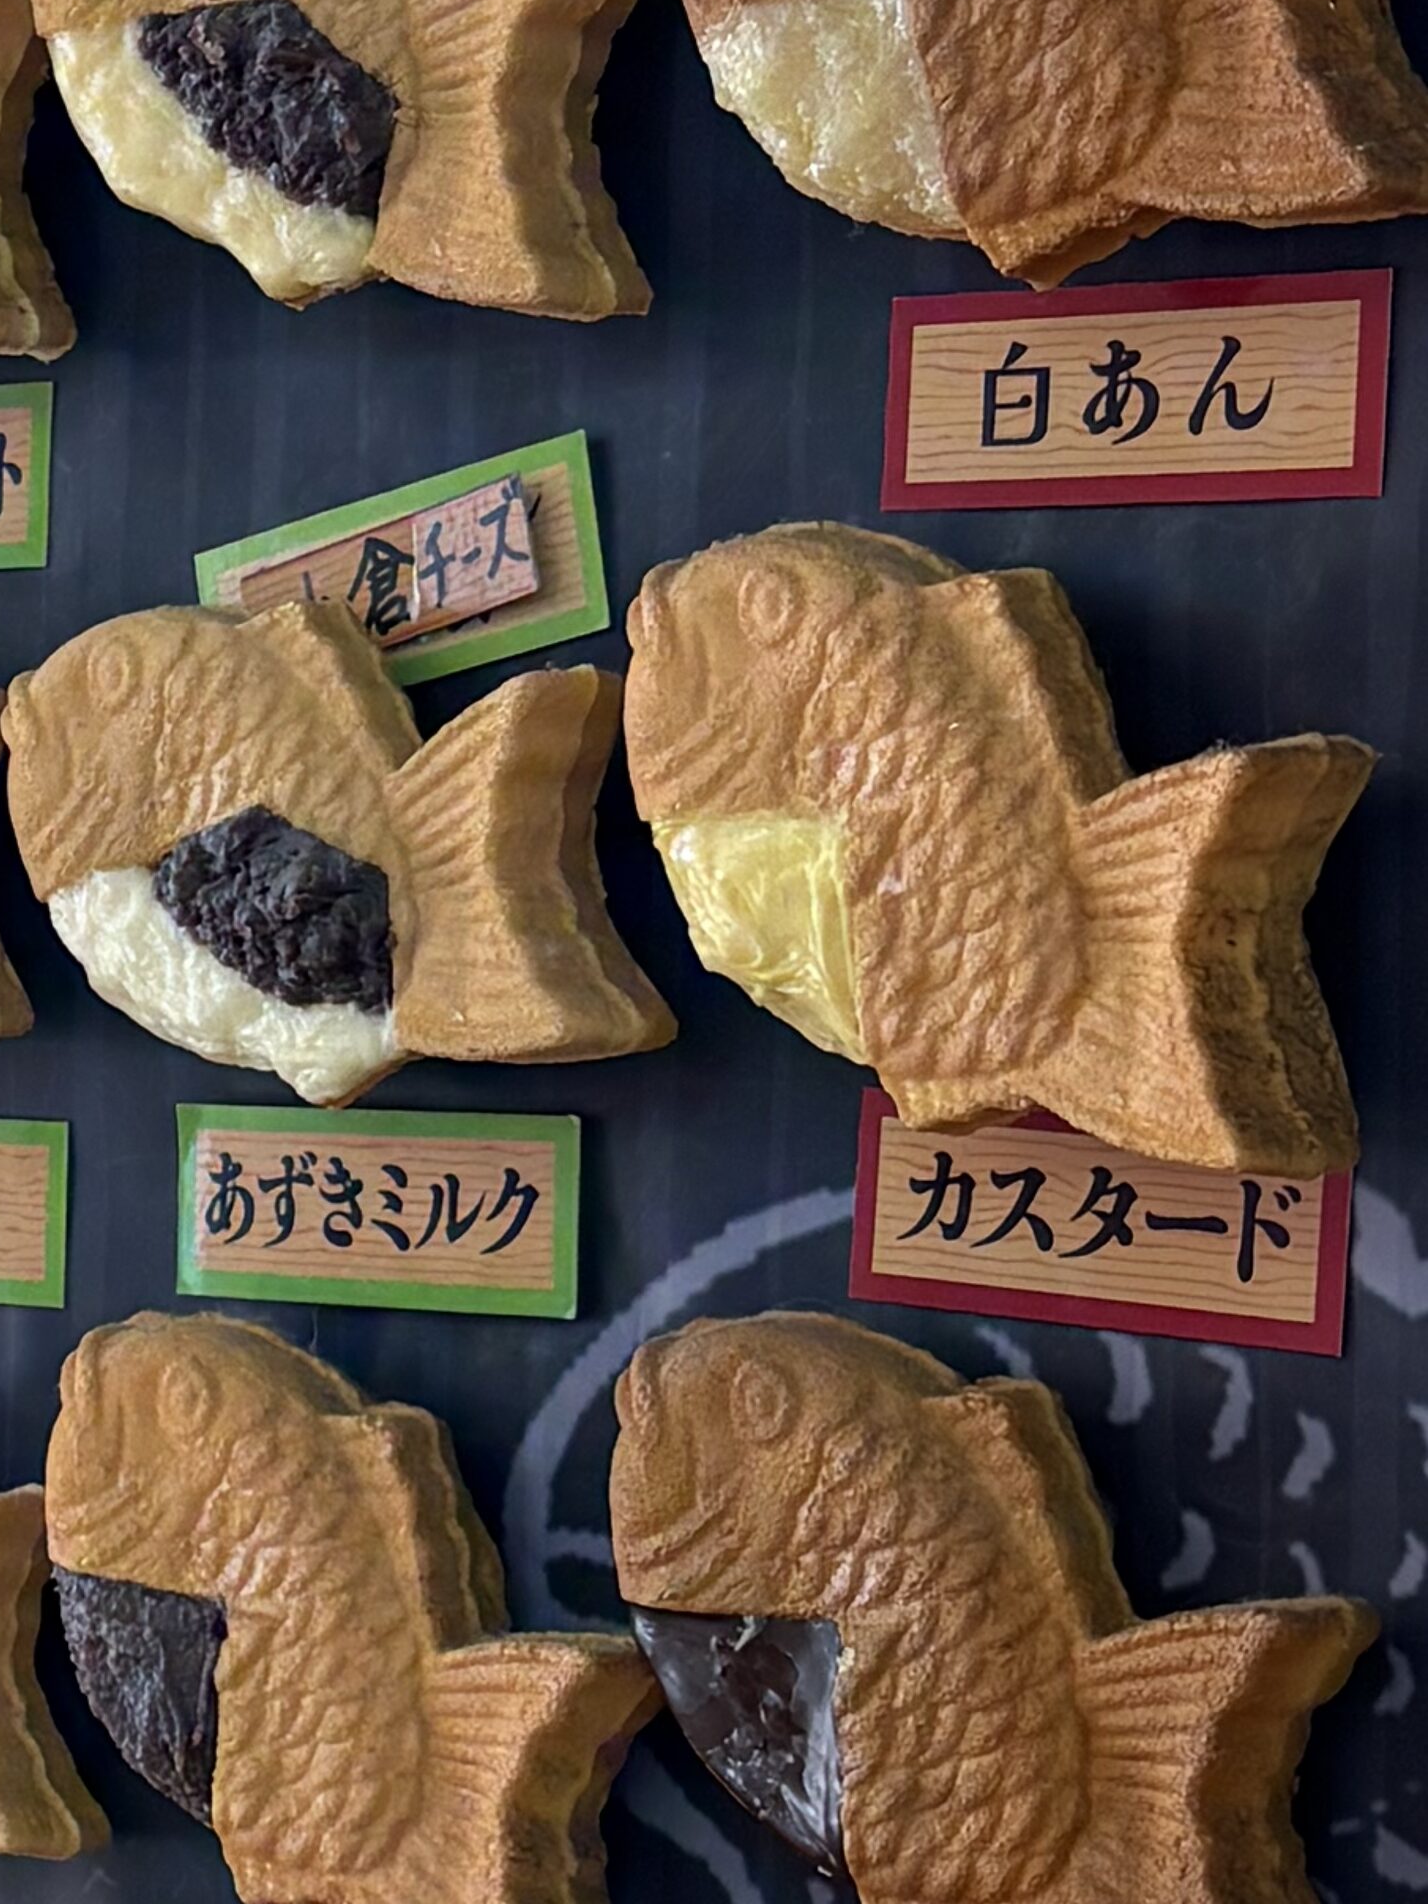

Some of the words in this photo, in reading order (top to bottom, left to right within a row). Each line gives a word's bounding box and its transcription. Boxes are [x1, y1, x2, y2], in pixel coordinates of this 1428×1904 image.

[982, 336, 1274, 449] 白あん
[204, 1149, 539, 1256] あずきミルク
[897, 1151, 1302, 1284] カスタード
